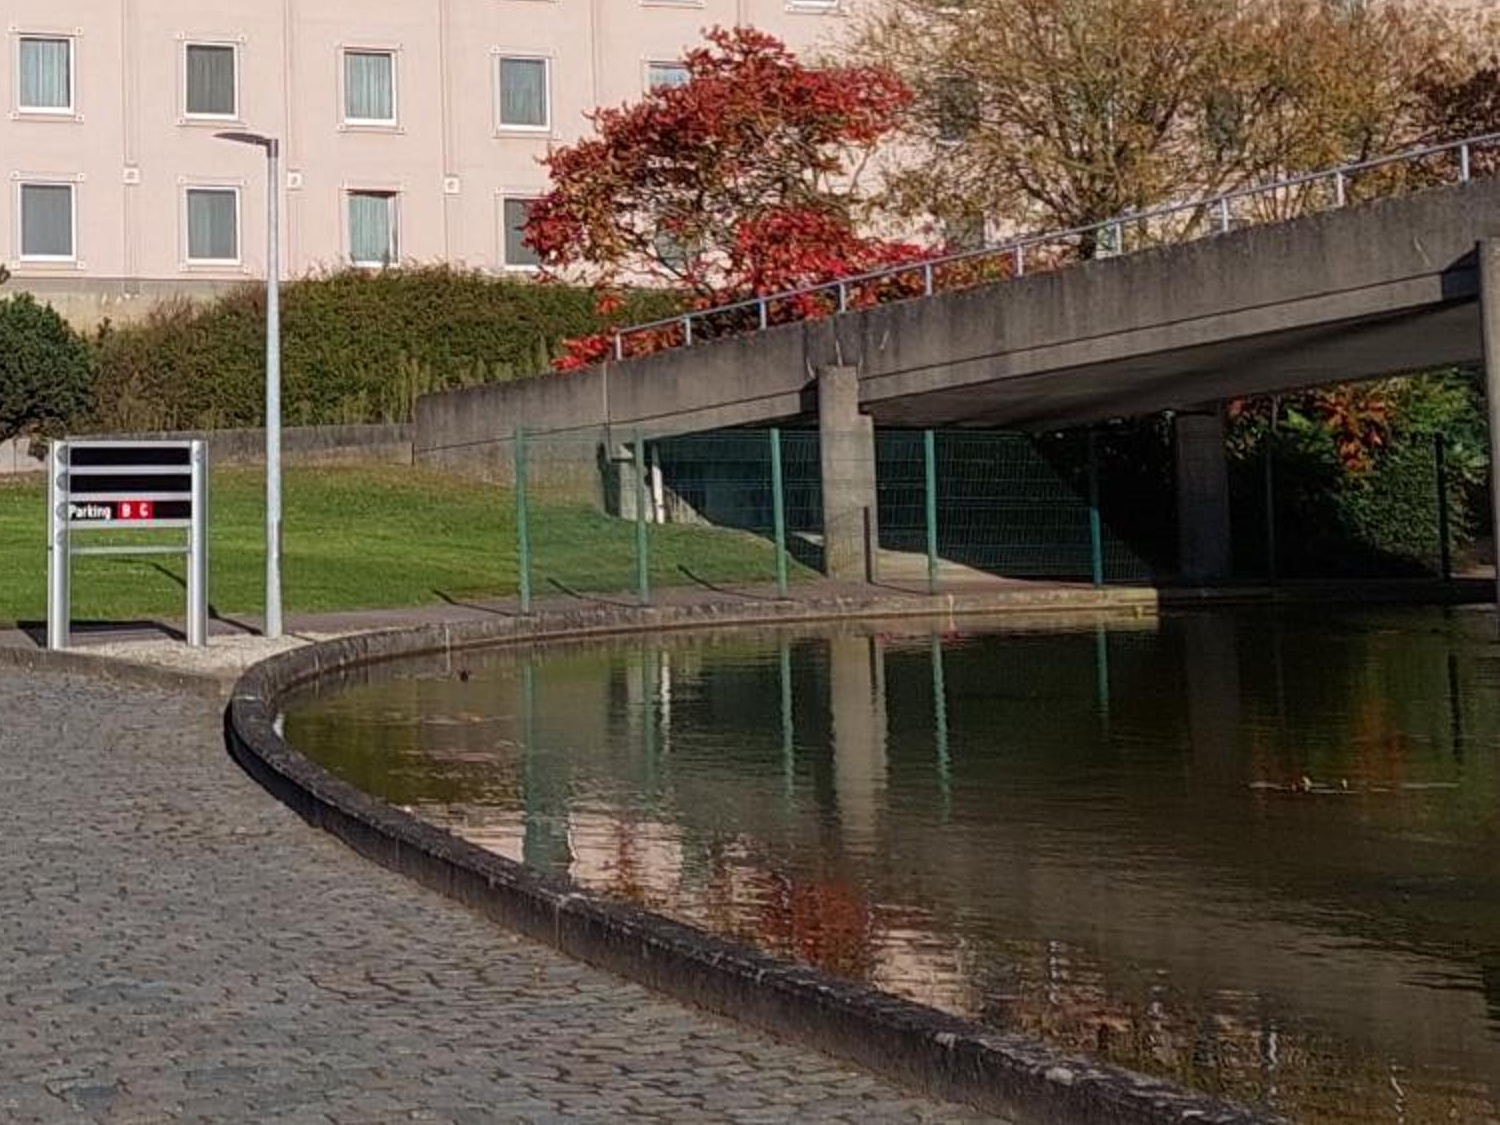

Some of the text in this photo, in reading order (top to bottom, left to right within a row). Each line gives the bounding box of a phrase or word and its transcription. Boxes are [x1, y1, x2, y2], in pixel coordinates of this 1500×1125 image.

[68, 502, 149, 520] Parking B C
